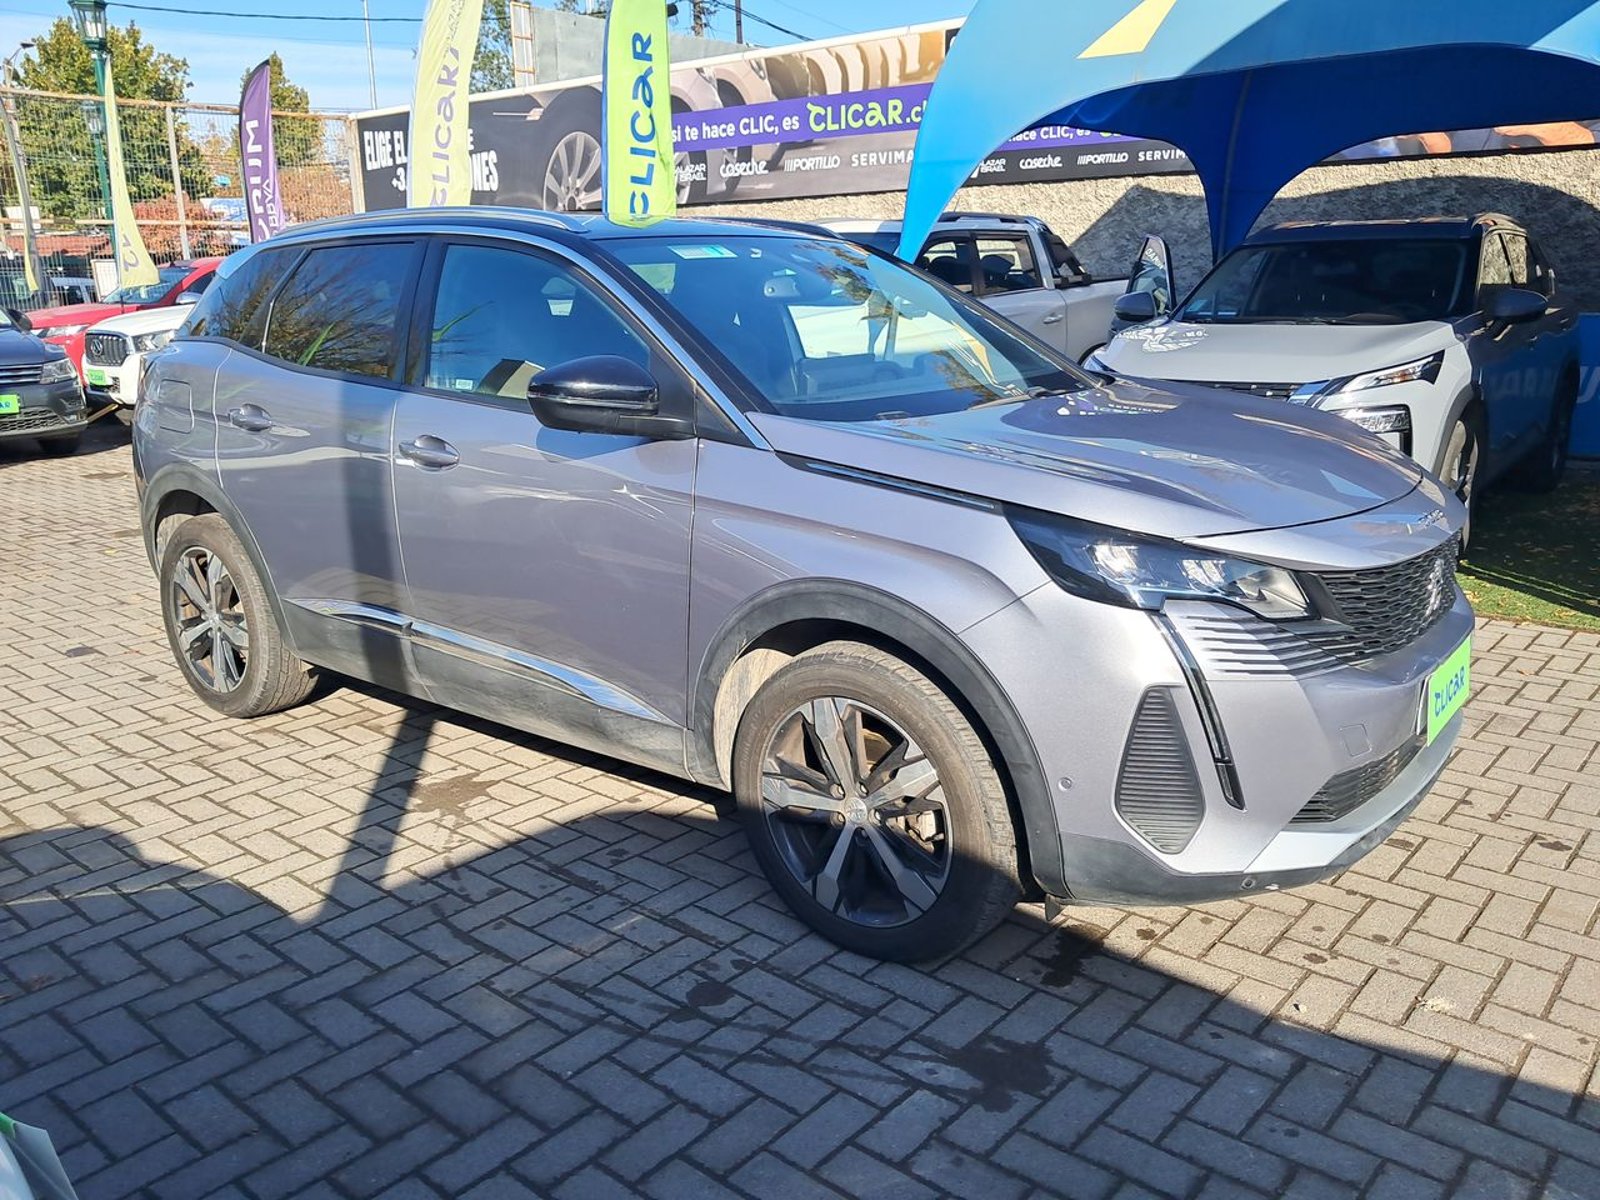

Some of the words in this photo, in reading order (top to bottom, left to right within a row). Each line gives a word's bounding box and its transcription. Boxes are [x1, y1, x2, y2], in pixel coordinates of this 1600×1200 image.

[684, 124, 699, 141] te
[702, 121, 736, 139] hace
[739, 114, 779, 135] CLIC,
[782, 116, 800, 131] es
[1009, 130, 1037, 142] ace
[363, 130, 393, 171] ELIGE
[1138, 149, 1188, 162] SERVIM
